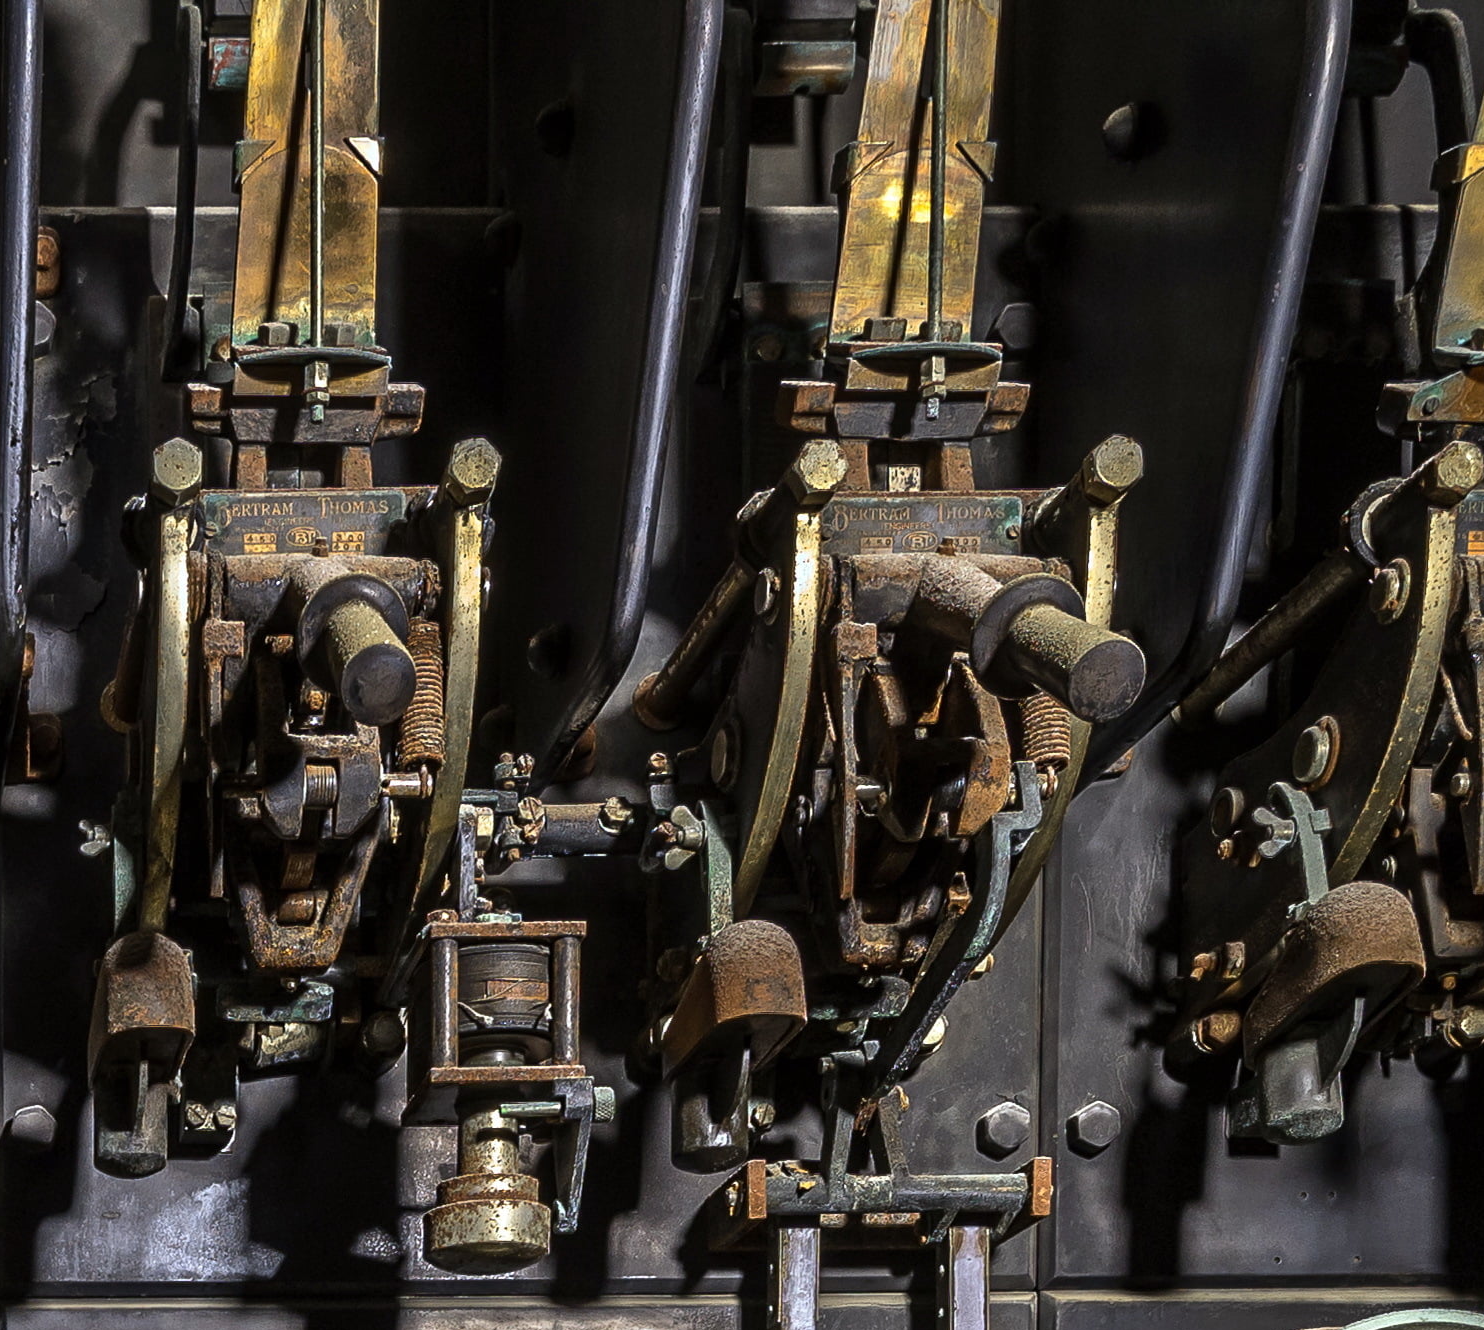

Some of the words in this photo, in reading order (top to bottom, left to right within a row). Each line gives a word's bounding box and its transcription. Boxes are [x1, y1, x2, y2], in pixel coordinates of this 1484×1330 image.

[218, 503, 293, 526] BERTRAM
[318, 497, 389, 518] THOMAS
[835, 506, 910, 531] BERTRAM
[937, 503, 1005, 525] THOMAS
